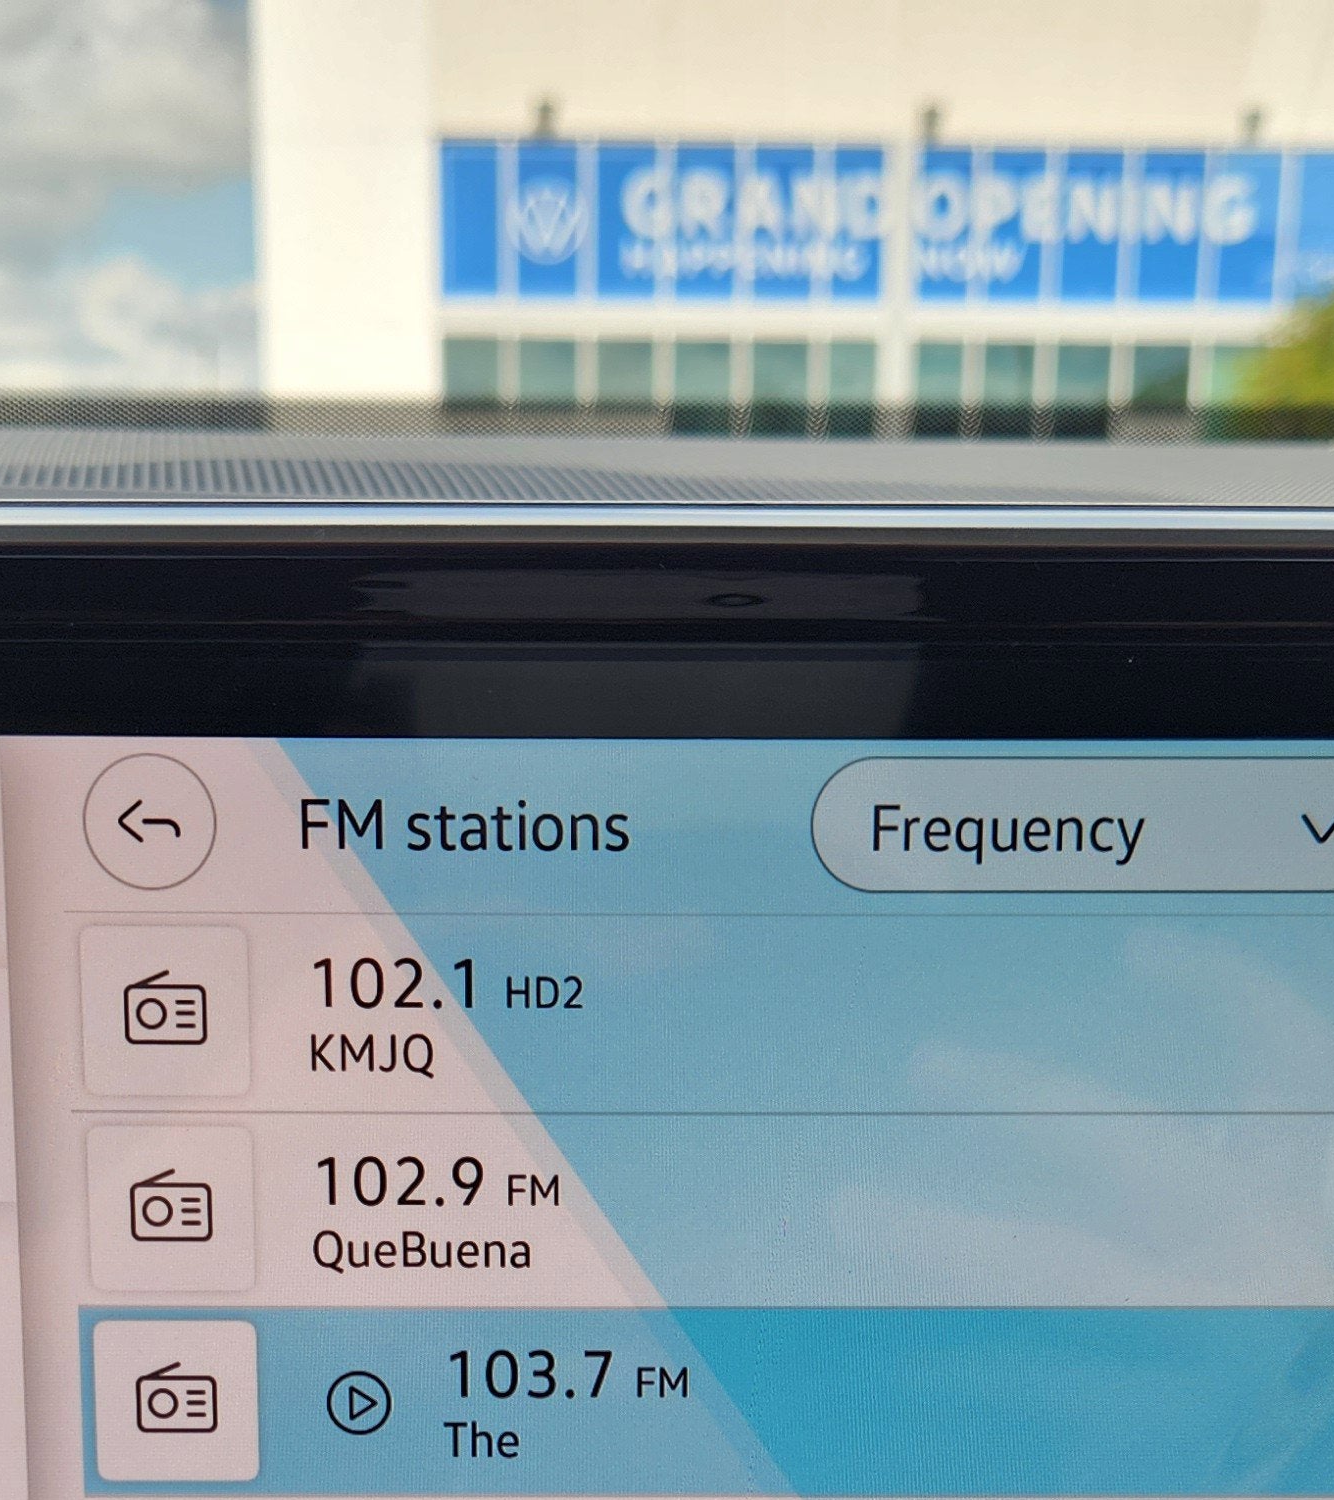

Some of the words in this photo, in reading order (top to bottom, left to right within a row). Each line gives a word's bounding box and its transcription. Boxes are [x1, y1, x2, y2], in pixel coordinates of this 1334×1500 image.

[620, 168, 887, 242] GRAND
[907, 172, 1258, 246] OPENING
[300, 797, 384, 851] FM
[406, 798, 631, 853] stations
[871, 803, 1146, 867] Frequency
[312, 956, 474, 1011] 102.1
[505, 974, 584, 1010] HD2
[309, 1032, 435, 1080] KMJQ
[316, 1154, 485, 1208] 102.9
[506, 1173, 560, 1208] FM
[311, 1229, 532, 1275] QueBuena
[448, 1348, 613, 1400] 103.7
[635, 1365, 689, 1399] FM
[442, 1419, 521, 1460] The
